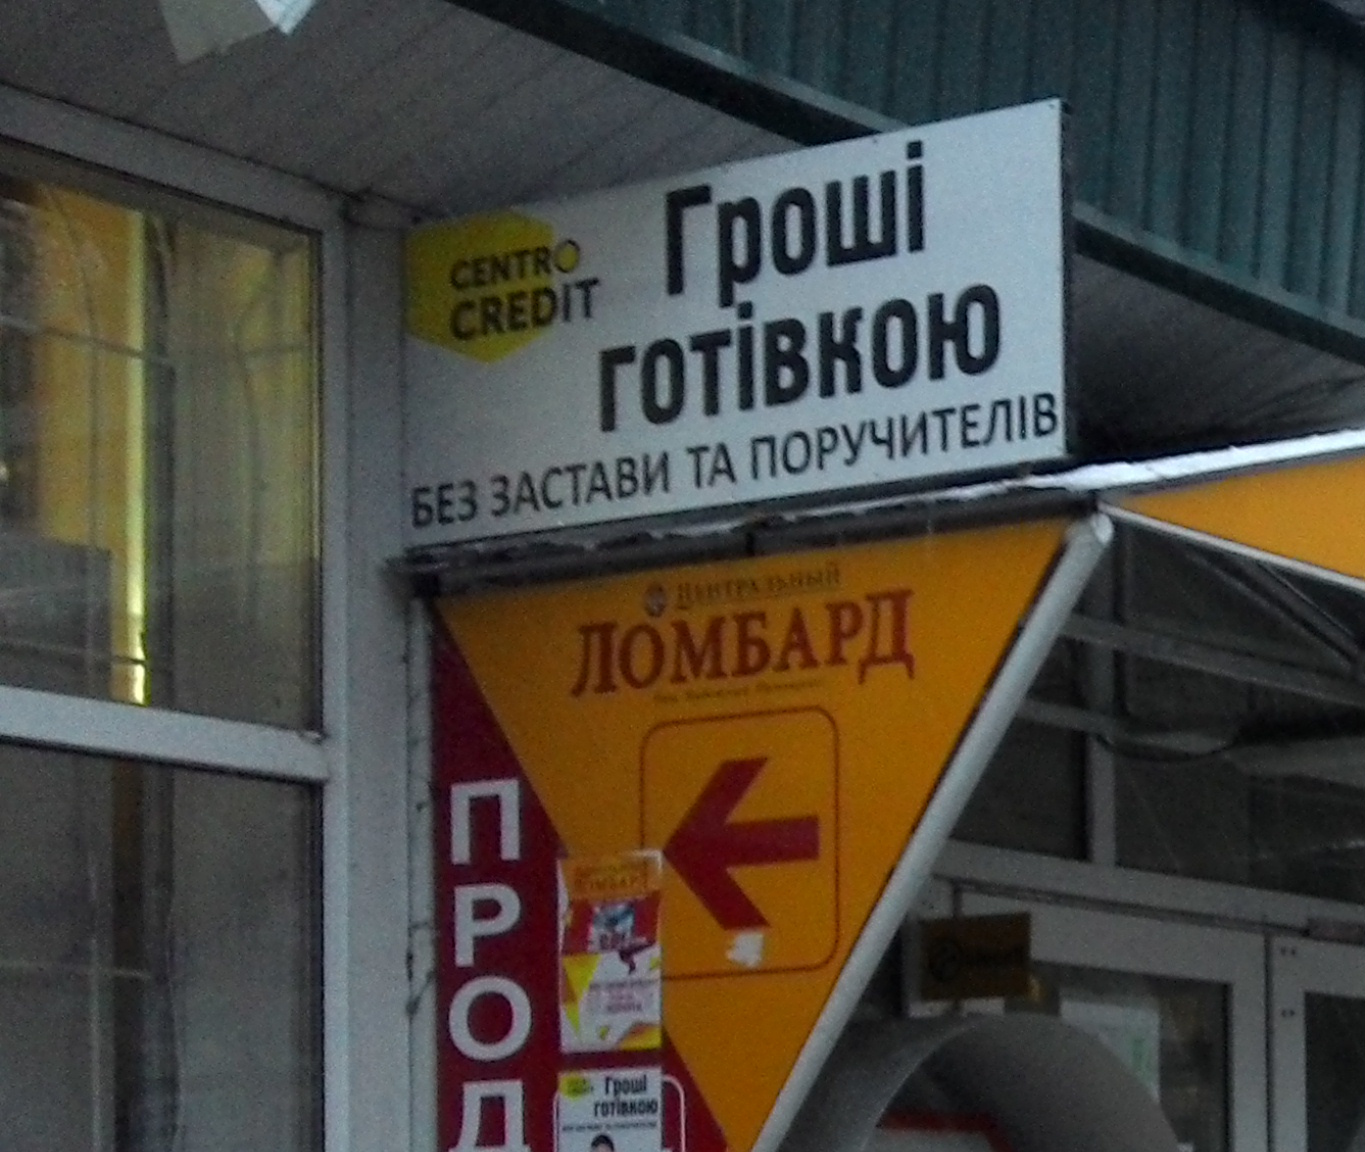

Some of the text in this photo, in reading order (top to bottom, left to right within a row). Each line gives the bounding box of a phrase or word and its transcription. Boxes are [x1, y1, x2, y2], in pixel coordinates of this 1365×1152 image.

[449, 239, 581, 292] CENTRO
[664, 140, 926, 307] Гроші
[449, 278, 600, 343] CREDIT
[600, 284, 1001, 433] готівкою
[411, 392, 1058, 529] БЕЗ ЗАСТАВИ ТА ПОРУЧИТЕЛІВ
[570, 588, 916, 698] ЛОМБАРД
[604, 1074, 647, 1097] Гроші
